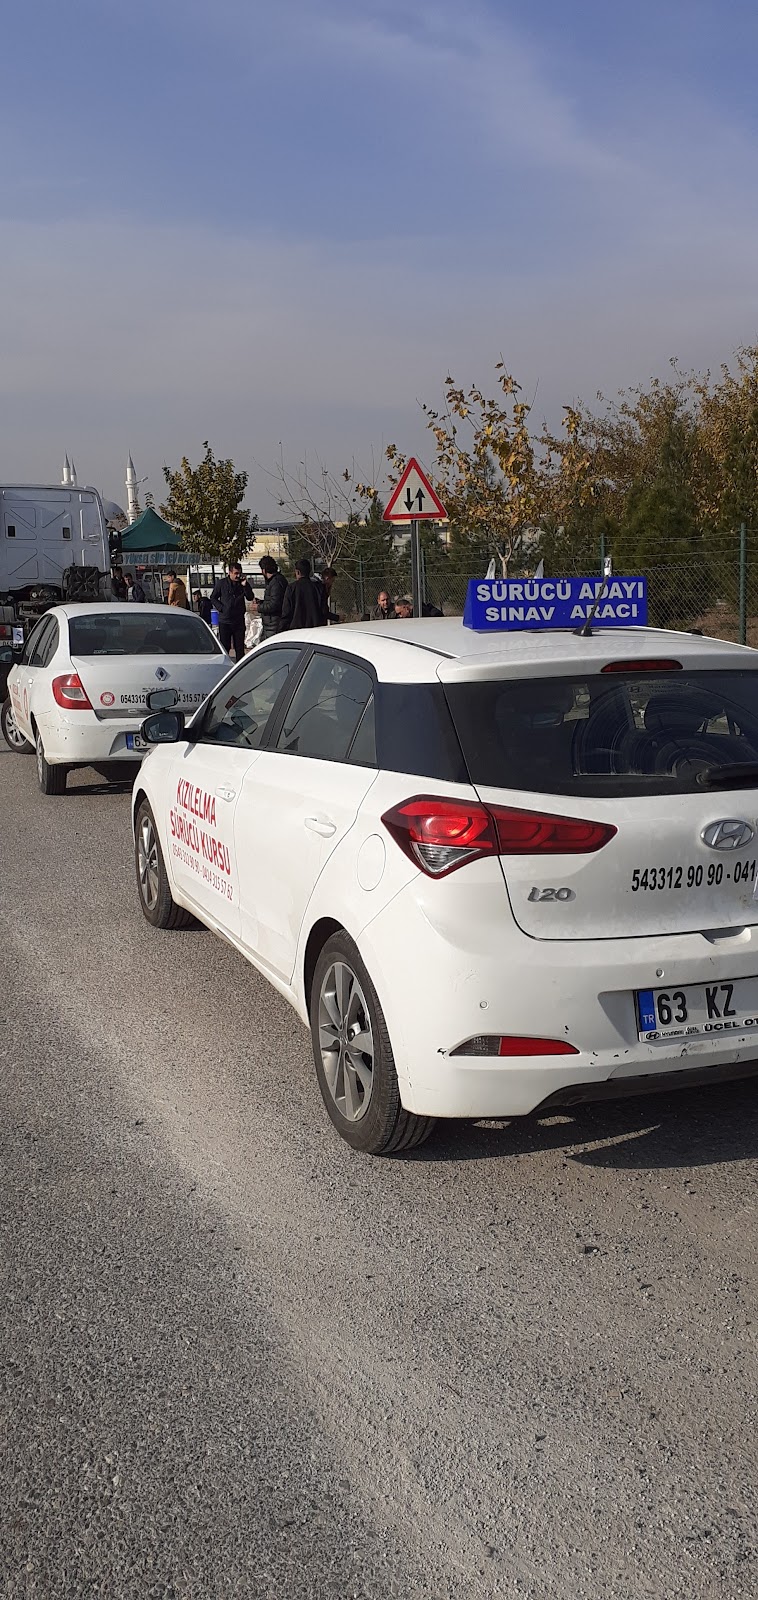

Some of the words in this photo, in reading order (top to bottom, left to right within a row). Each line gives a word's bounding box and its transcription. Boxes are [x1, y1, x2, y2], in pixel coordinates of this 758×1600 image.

[476, 580, 571, 602] SÜRÜCÜ
[578, 581, 644, 600] ADAYI
[485, 606, 555, 622] SINAV
[569, 603, 638, 619] ARACI
[120, 694, 146, 704] 0543312
[182, 694, 193, 703] 315
[194, 693, 201, 703] 57
[176, 777, 217, 827] KIZILELMA
[170, 806, 200, 853] SÜRÜCÜ
[200, 830, 231, 876] KURSU
[631, 866, 683, 892] 543312
[687, 864, 703, 888] 90
[707, 863, 724, 886] 90
[733, 859, 758, 884] 041
[657, 991, 688, 1025] 63
[705, 983, 736, 1019] KZ
[643, 1014, 655, 1024] TR
[704, 1021, 740, 1032] ÜCEL
